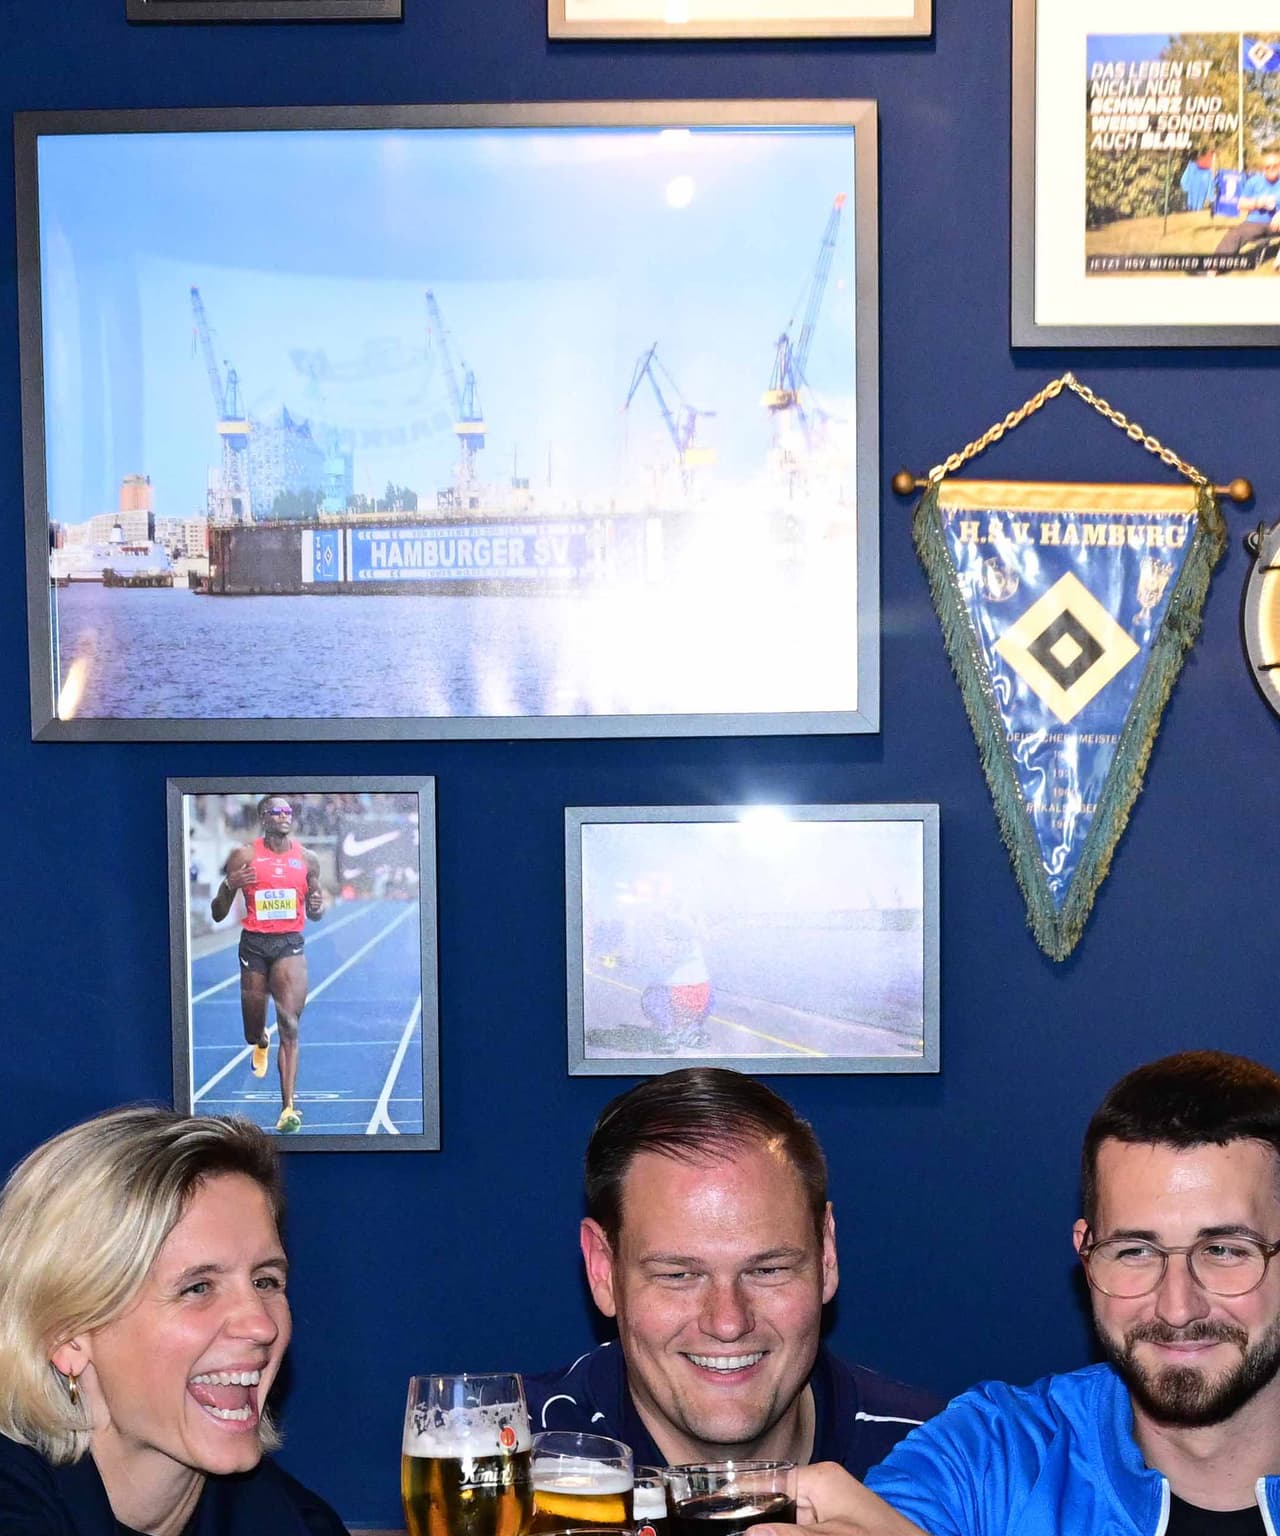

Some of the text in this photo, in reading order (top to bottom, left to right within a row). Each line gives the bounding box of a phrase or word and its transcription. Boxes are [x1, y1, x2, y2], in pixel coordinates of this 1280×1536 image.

[1091, 61, 1213, 80] DAS LEBEN IST
[1091, 79, 1181, 98] NICHT NUR
[1091, 97, 1222, 116] SCHWARZ UND
[1157, 114, 1239, 132] SONDERN
[1091, 132, 1138, 151] AUCH
[959, 521, 1186, 548] H.S.V. HAMBURG
[370, 538, 526, 568] HAMBURGER
[262, 900, 291, 910] ANSAH
